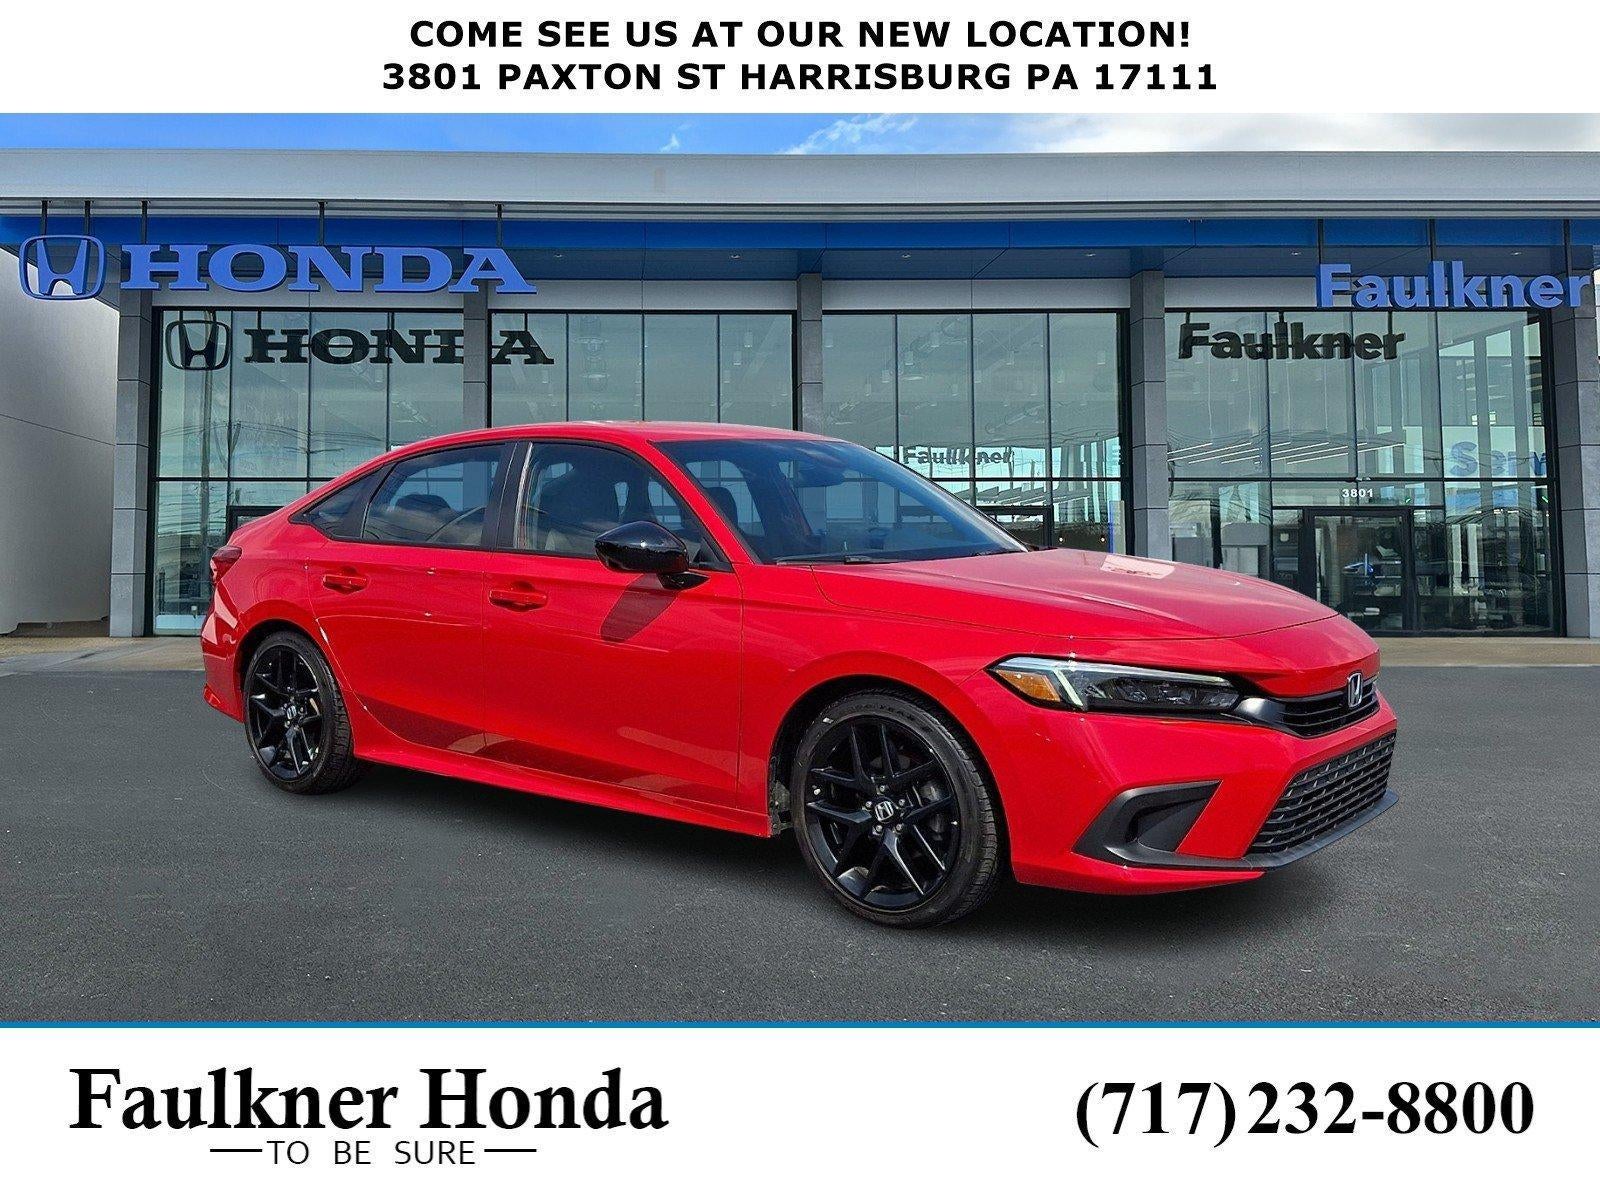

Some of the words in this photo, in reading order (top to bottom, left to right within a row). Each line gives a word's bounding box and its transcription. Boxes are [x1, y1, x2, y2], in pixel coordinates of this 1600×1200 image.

[120, 243, 537, 294] HONDA
[1316, 260, 1590, 308] Faulkner
[1178, 321, 1405, 360] Faulkner
[1342, 488, 1373, 498] 3801
